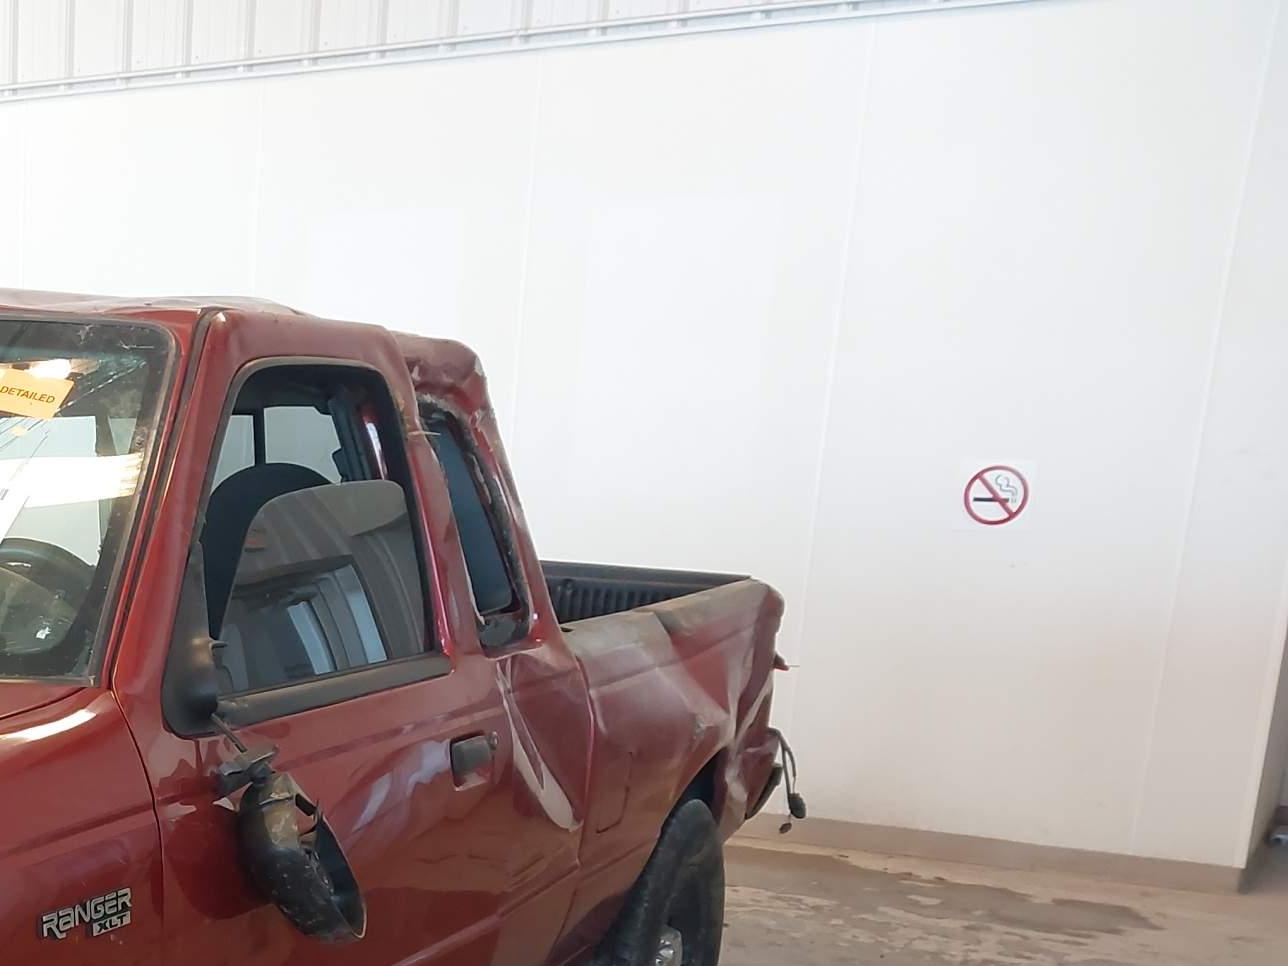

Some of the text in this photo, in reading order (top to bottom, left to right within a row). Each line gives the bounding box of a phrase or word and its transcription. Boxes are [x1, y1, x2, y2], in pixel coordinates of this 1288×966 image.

[0, 385, 56, 404] DETAILED
[42, 887, 132, 939] RANGER
[97, 914, 127, 933] XLT
